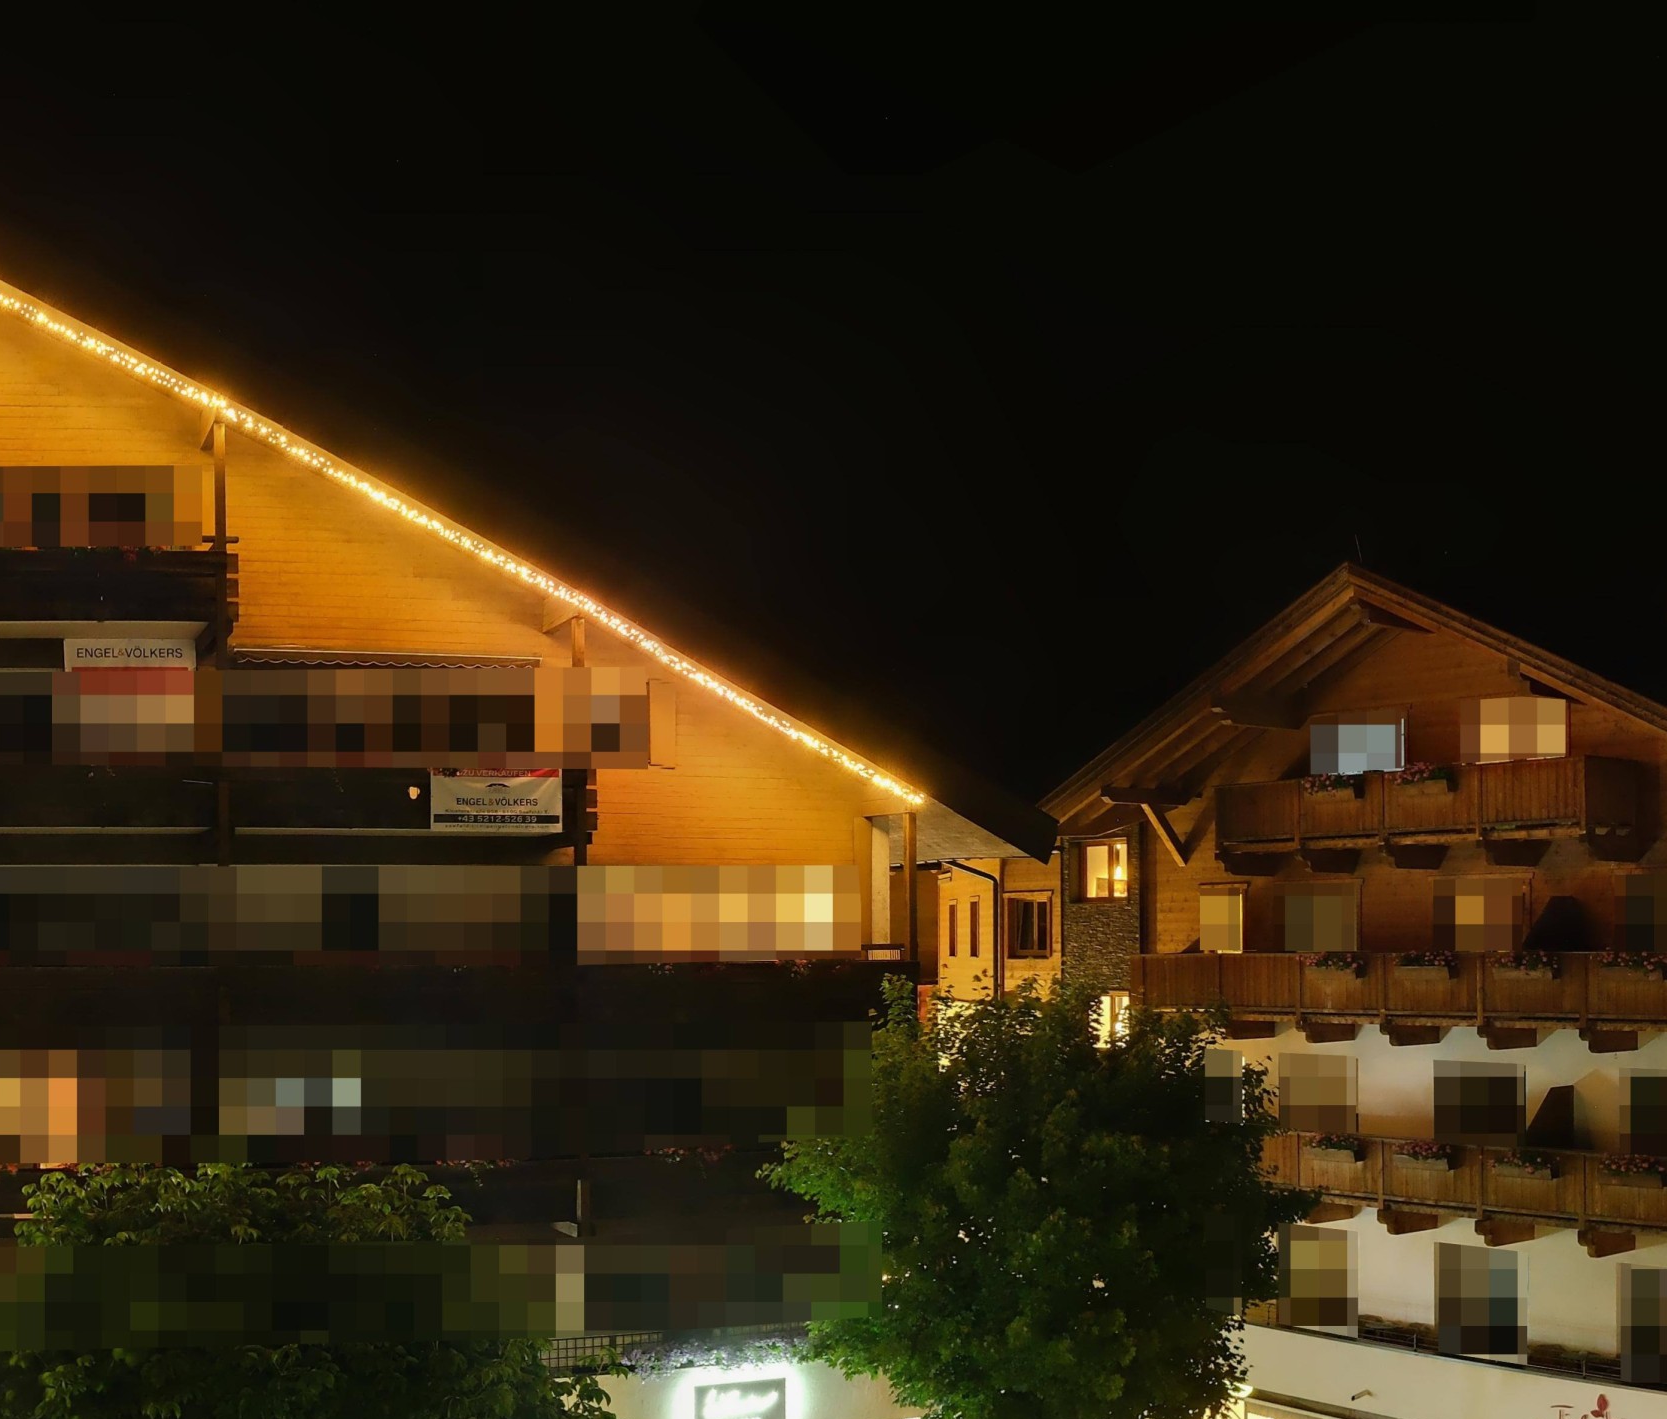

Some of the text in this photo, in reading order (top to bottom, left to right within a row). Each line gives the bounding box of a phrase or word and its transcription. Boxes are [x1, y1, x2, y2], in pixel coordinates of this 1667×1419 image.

[477, 769, 532, 777] VERKAUFEN
[458, 815, 475, 823] +43
[525, 815, 537, 823] 39
